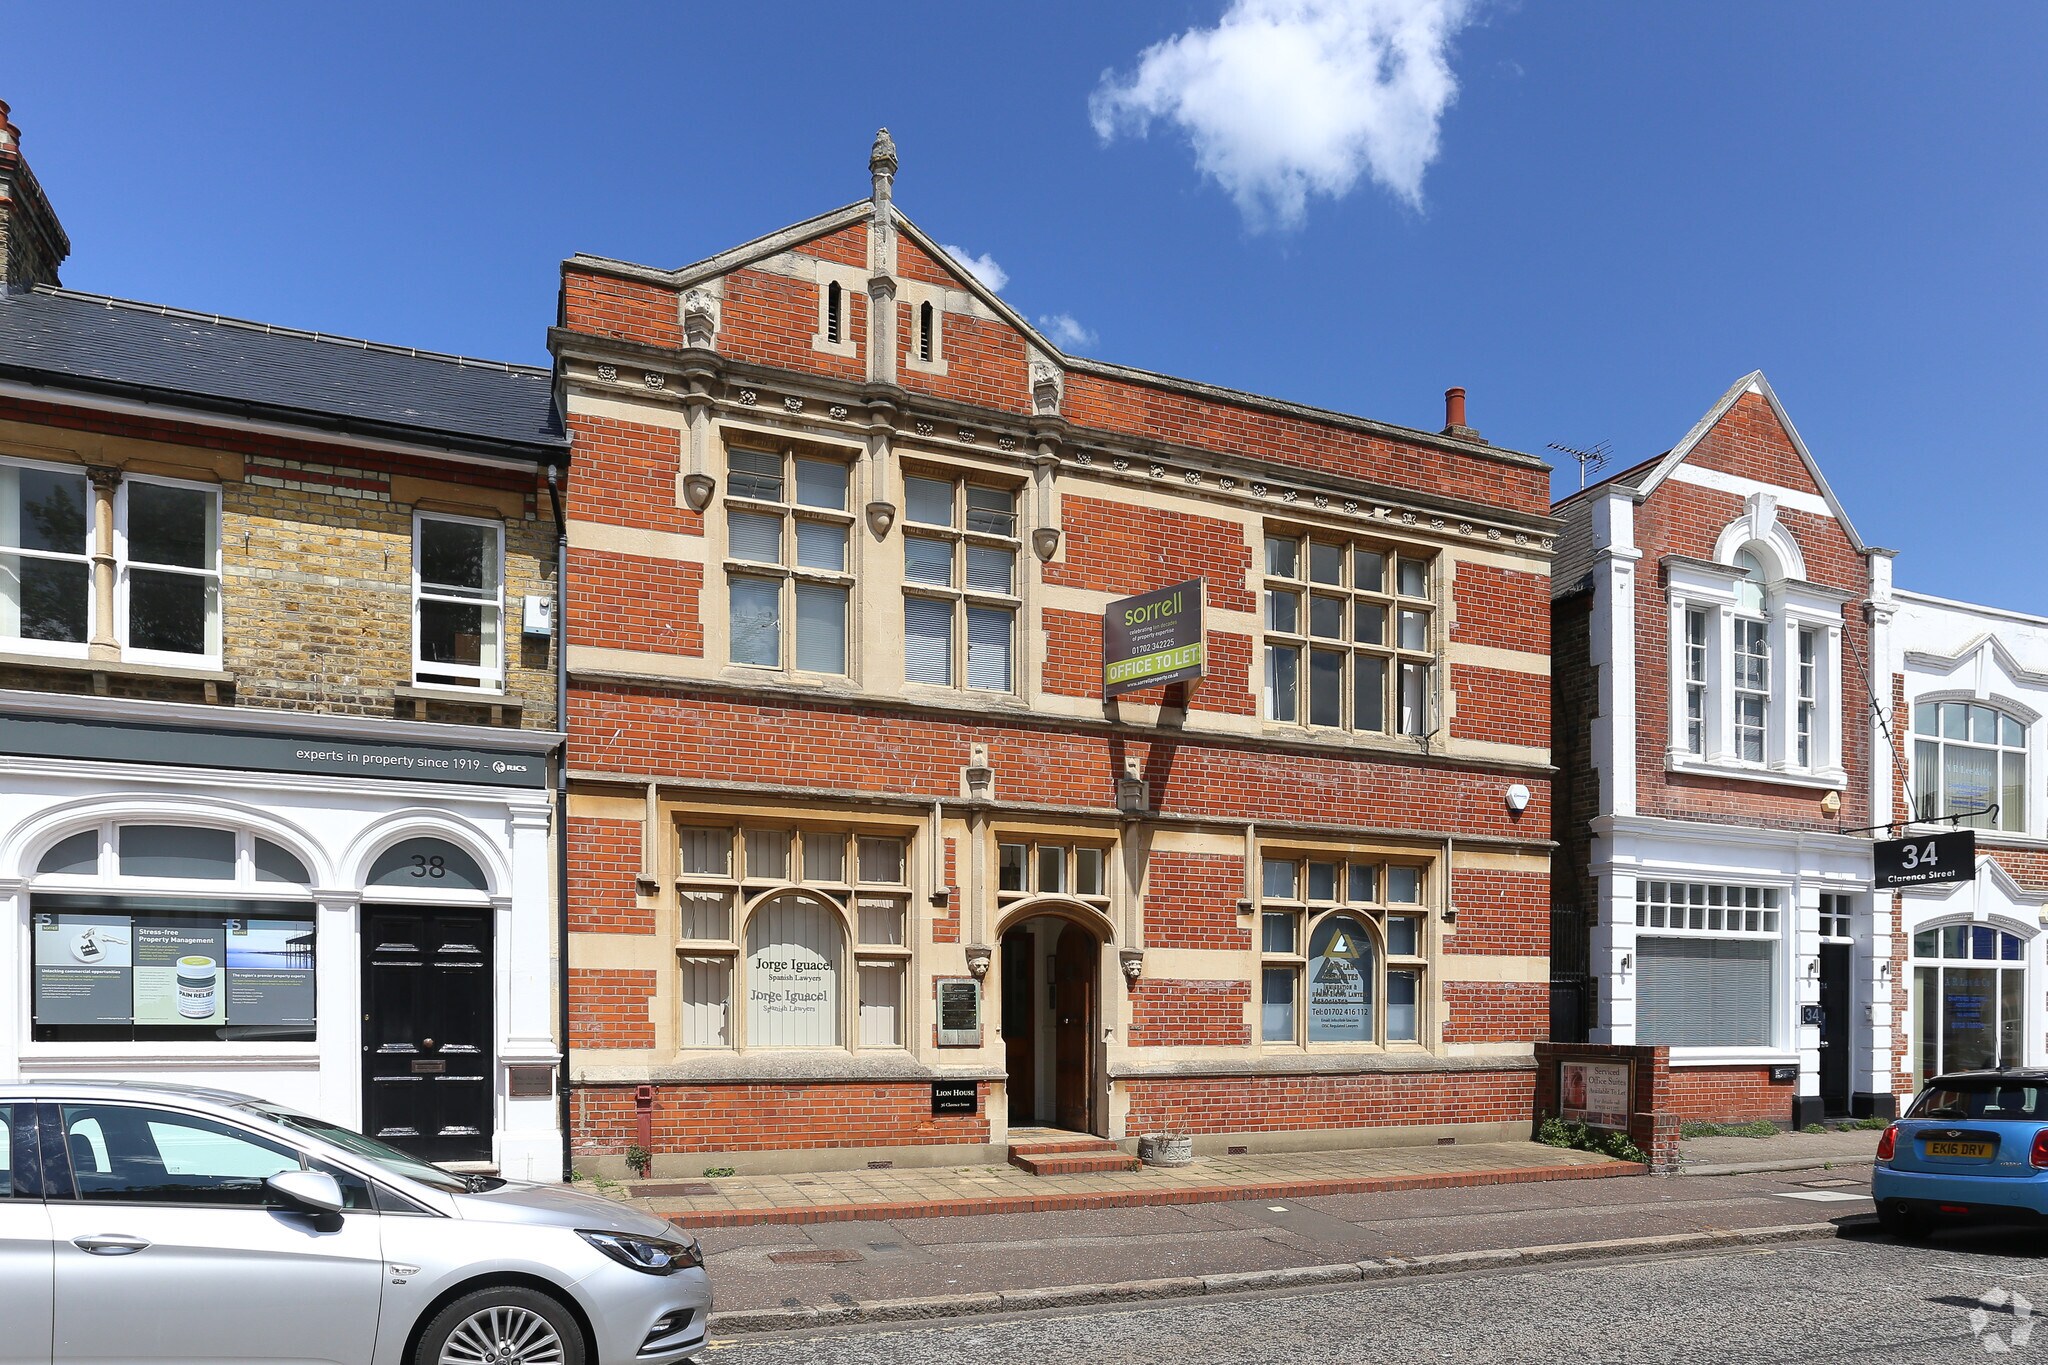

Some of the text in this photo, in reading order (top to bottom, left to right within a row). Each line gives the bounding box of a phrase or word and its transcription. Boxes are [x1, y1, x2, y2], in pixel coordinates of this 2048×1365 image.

[1125, 591, 1182, 626] sorrell
[1129, 626, 1153, 636] celebrating
[1137, 632, 1155, 641] property
[1155, 628, 1174, 638] expertise
[1131, 638, 1175, 655] 01702 342225
[1110, 647, 1197, 680] OFFICE TO LET
[296, 749, 344, 761] experts
[347, 751, 358, 762] in
[362, 753, 414, 768] property
[417, 757, 449, 768] since
[453, 758, 480, 770] 1919
[1902, 841, 1938, 869] 34
[410, 854, 445, 878] 38
[1888, 869, 1955, 882] Clarence Street
[139, 936, 169, 944] Property
[756, 958, 833, 973] Jorge Iguacel
[769, 974, 821, 982] Spanish Lawyers
[1805, 1008, 1819, 1021] 34
[1594, 1067, 1619, 1075] Serviced
[1589, 1076, 1626, 1085] Office Suites
[1932, 1143, 1985, 1155] EK16 DRV
